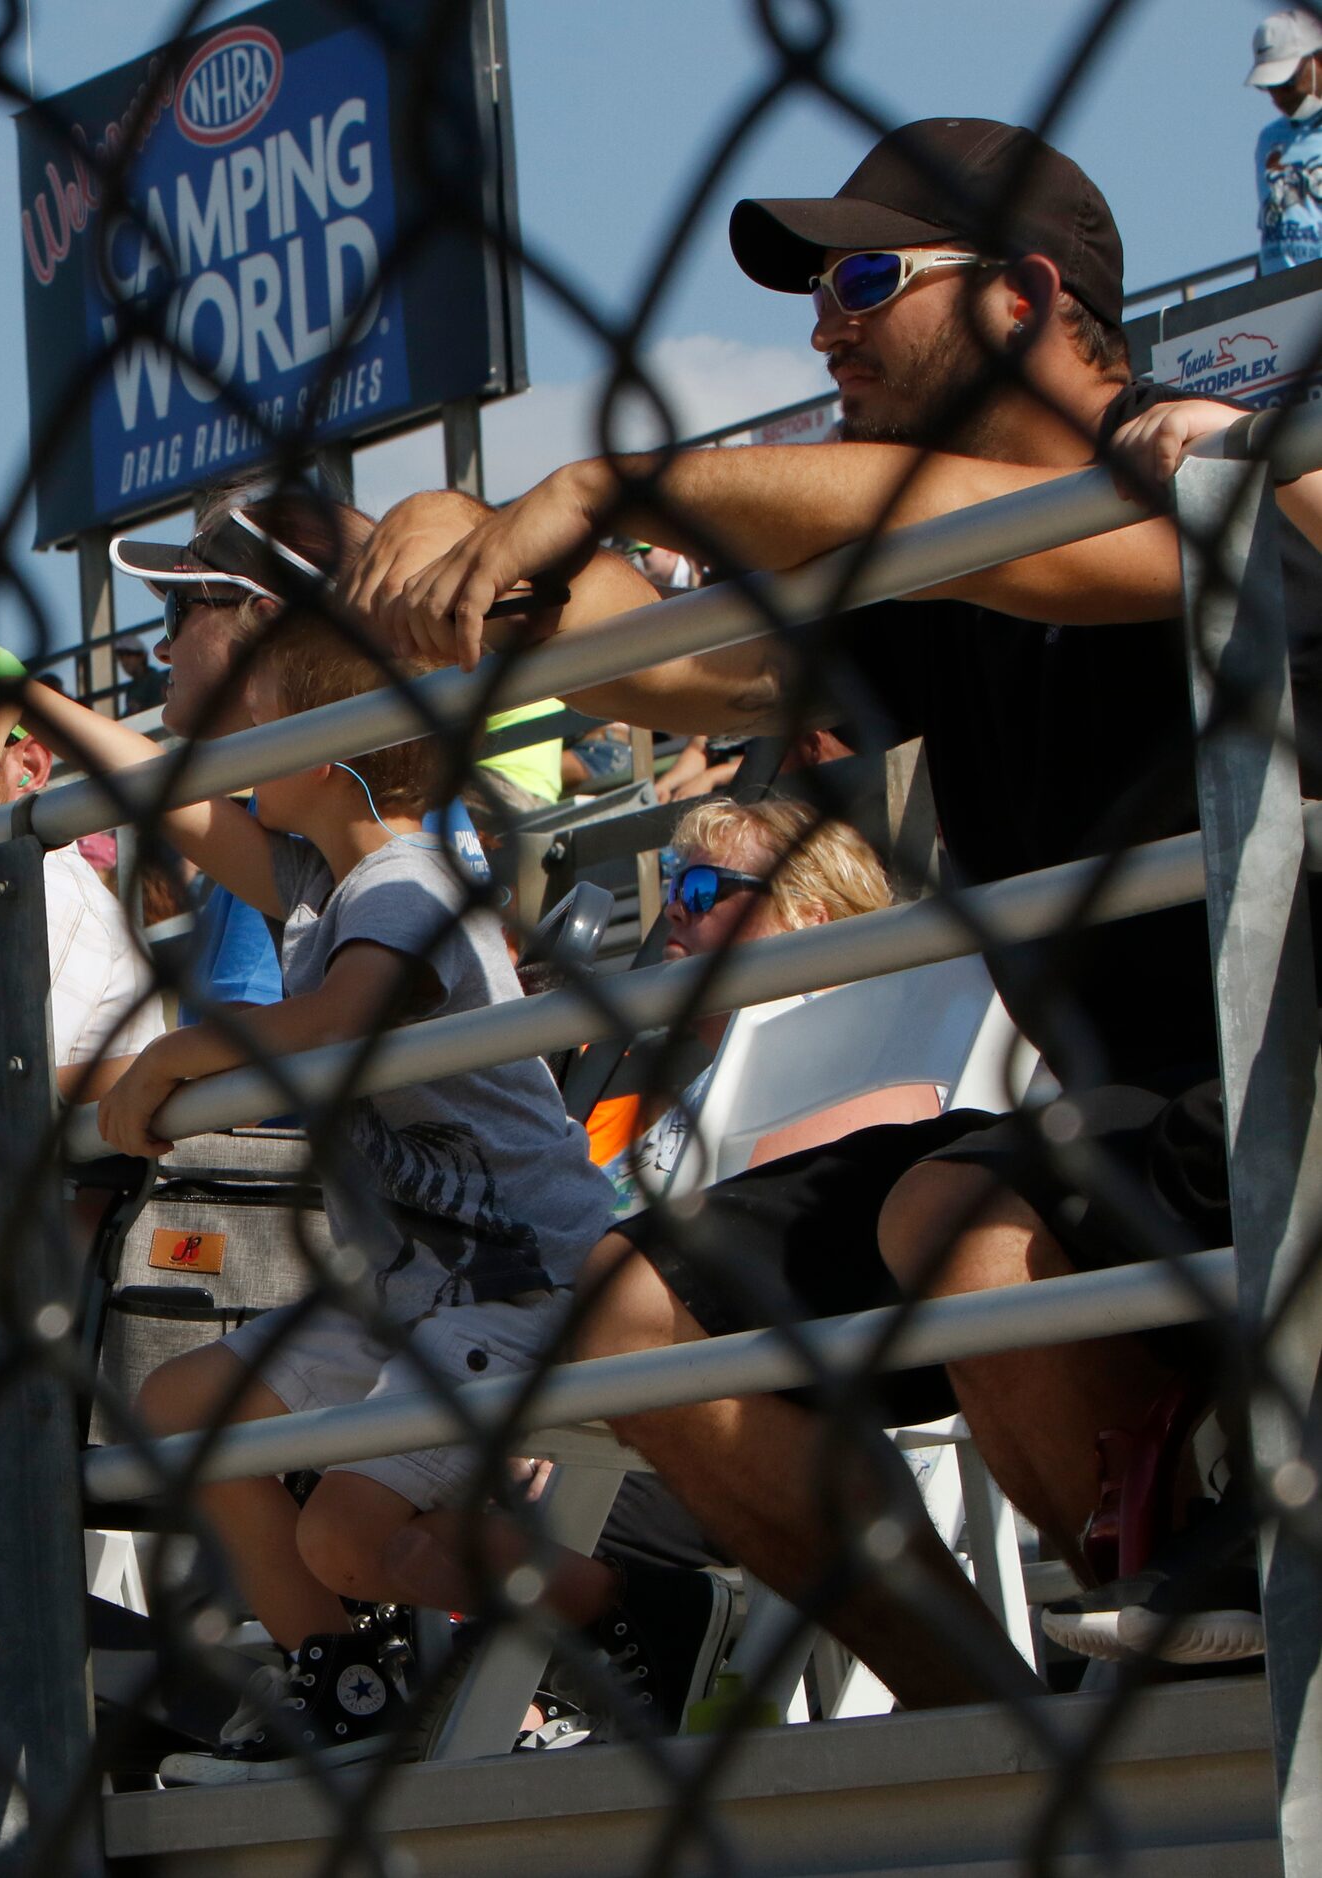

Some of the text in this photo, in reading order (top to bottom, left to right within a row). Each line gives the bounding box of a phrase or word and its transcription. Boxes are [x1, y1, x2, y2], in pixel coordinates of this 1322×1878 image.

[189, 48, 268, 131] NHRA
[98, 98, 374, 304] CAMPING
[1177, 348, 1216, 385] Texas
[1178, 354, 1278, 394] OTORPLEX
[120, 433, 184, 495] DRAG
[192, 395, 285, 469] RACING
